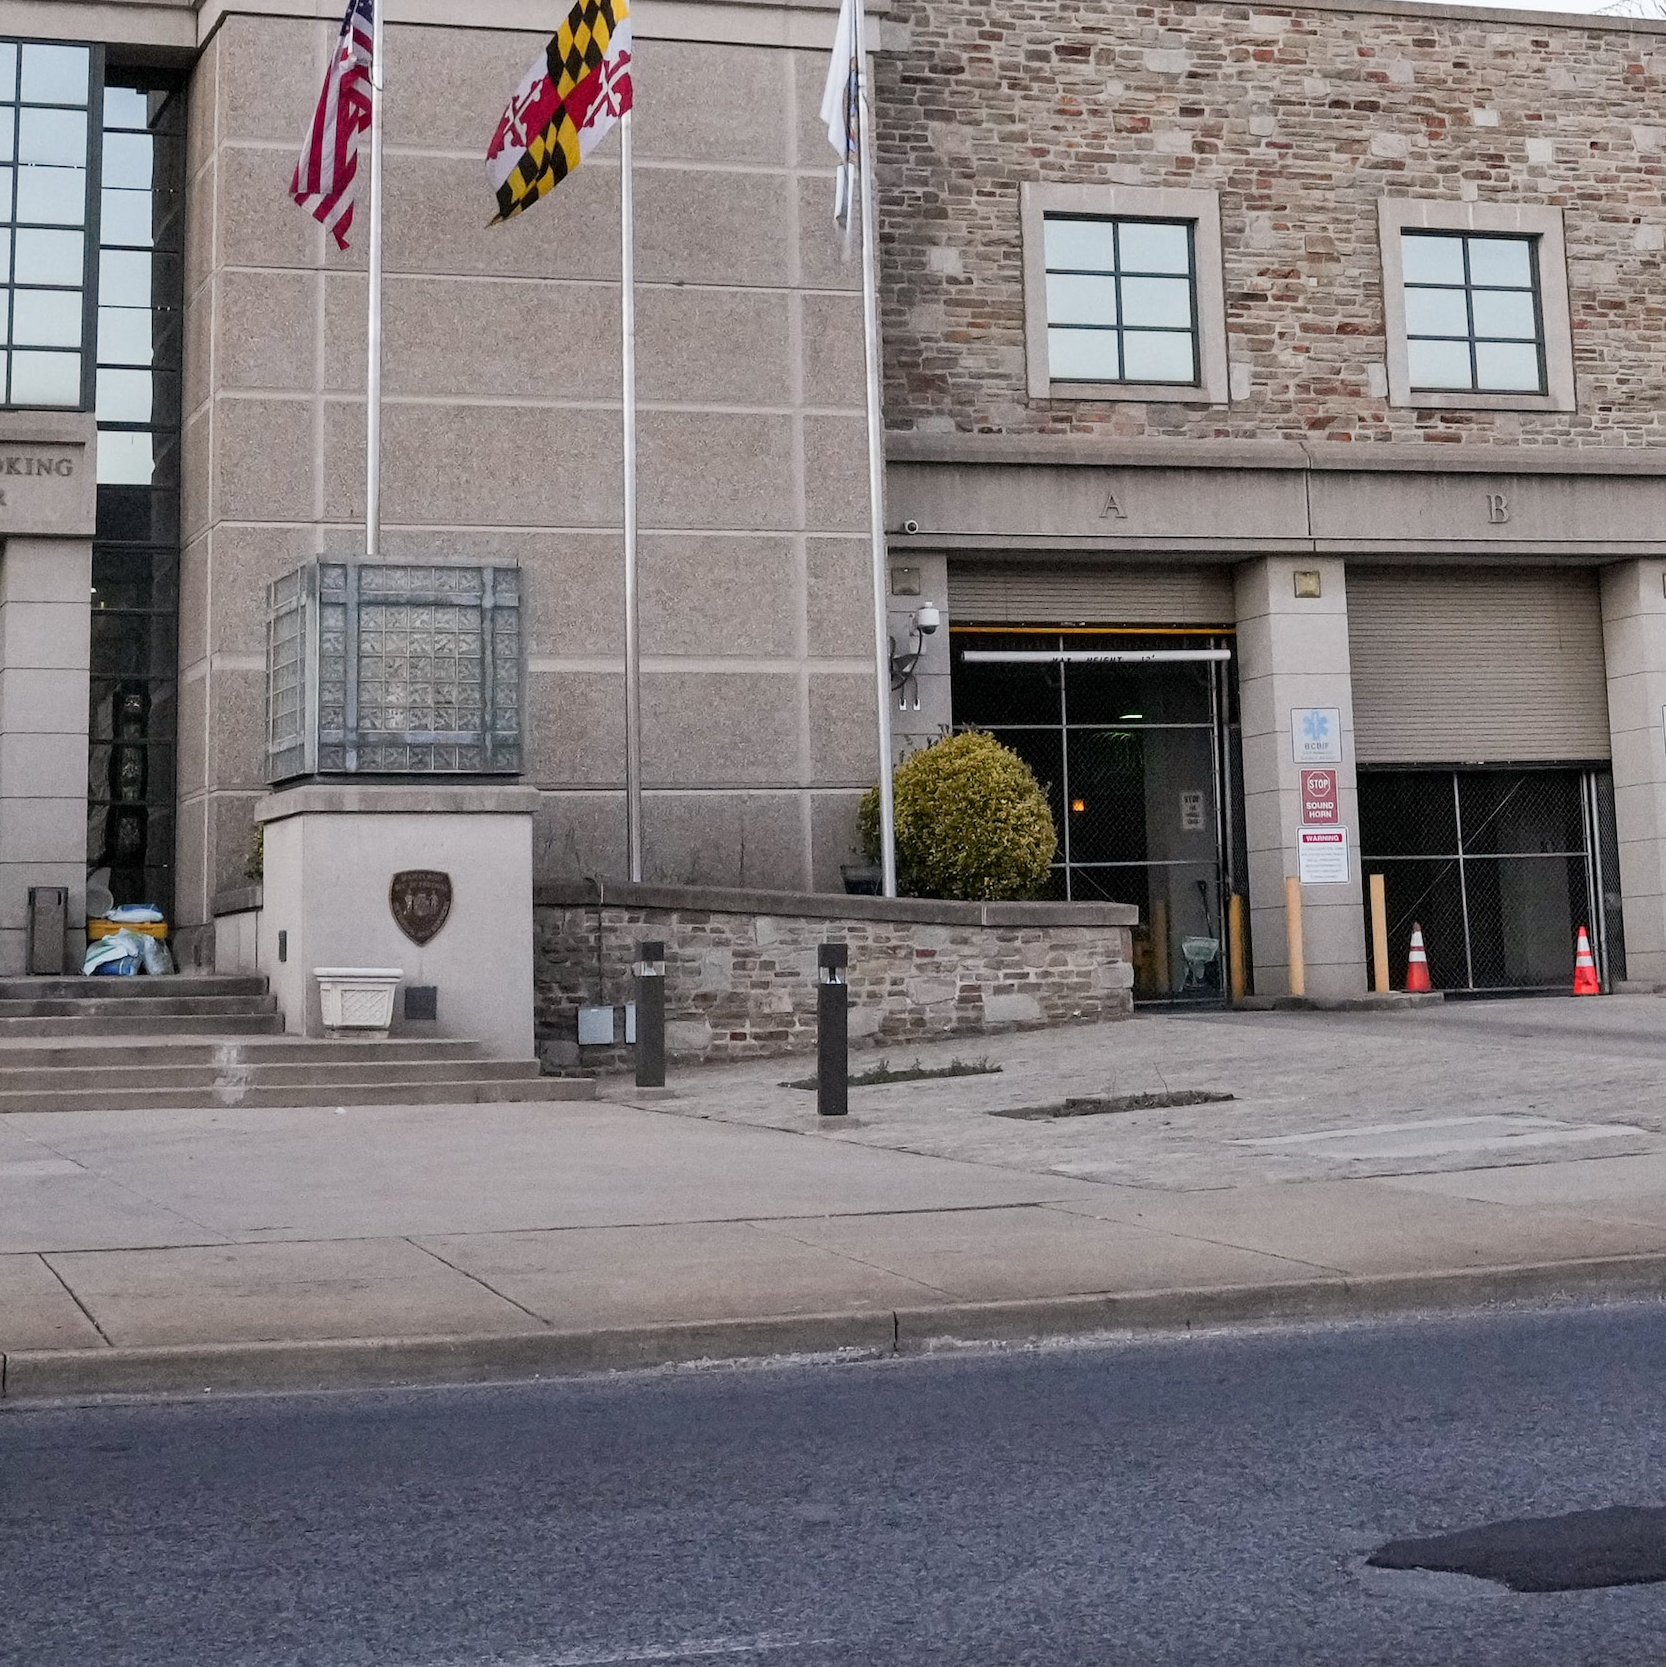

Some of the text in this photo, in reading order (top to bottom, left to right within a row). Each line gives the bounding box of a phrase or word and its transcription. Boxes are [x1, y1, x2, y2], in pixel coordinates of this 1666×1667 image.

[1099, 491, 1128, 519] A
[1486, 493, 1512, 524] B
[1309, 779, 1329, 789] STOP
[1306, 801, 1334, 810] SOUND
[1308, 810, 1332, 819] HORN
[1305, 834, 1340, 842] WARNING
